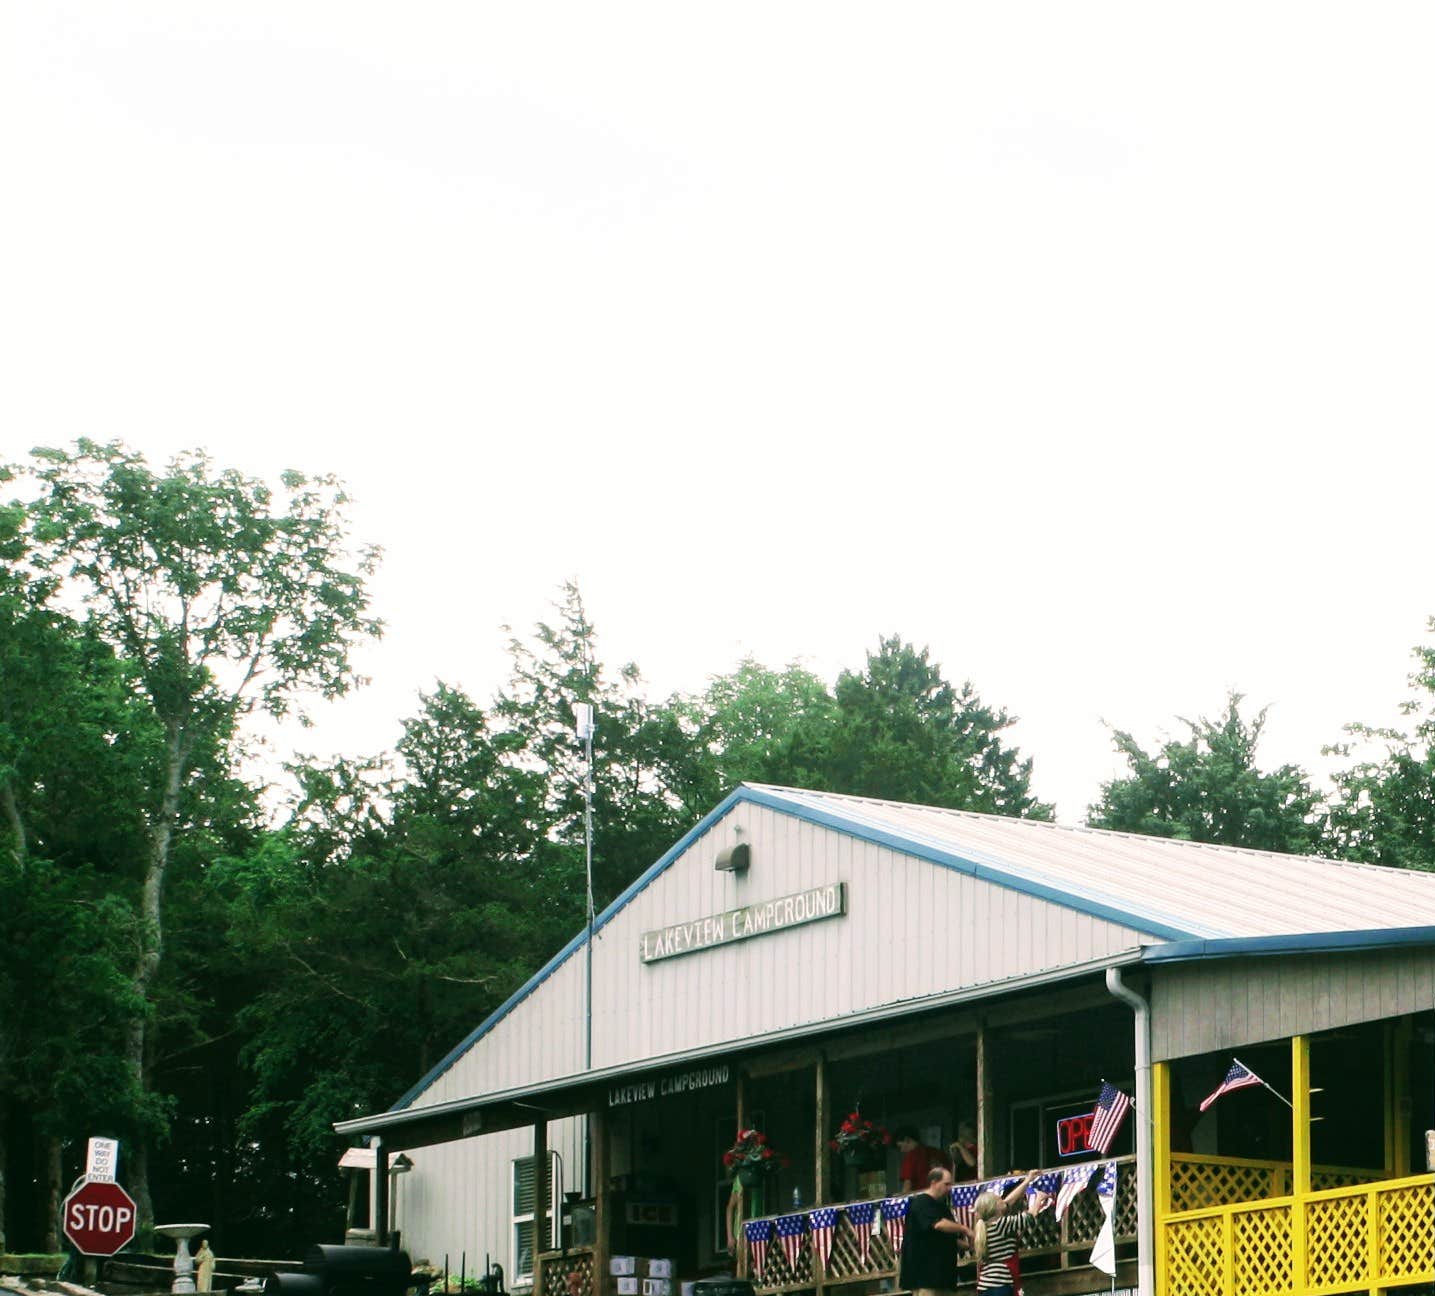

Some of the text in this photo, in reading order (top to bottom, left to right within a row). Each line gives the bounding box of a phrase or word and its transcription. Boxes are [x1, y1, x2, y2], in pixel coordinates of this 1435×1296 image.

[644, 887, 836, 960] LAKEVIEW CAMPGROUND
[608, 1066, 729, 1107] LAKEVIEW CAMPGROUND
[95, 1141, 111, 1149] ONE
[1060, 1115, 1096, 1153] OPE
[88, 1174, 114, 1182] ENTER
[70, 1204, 131, 1233] STOP
